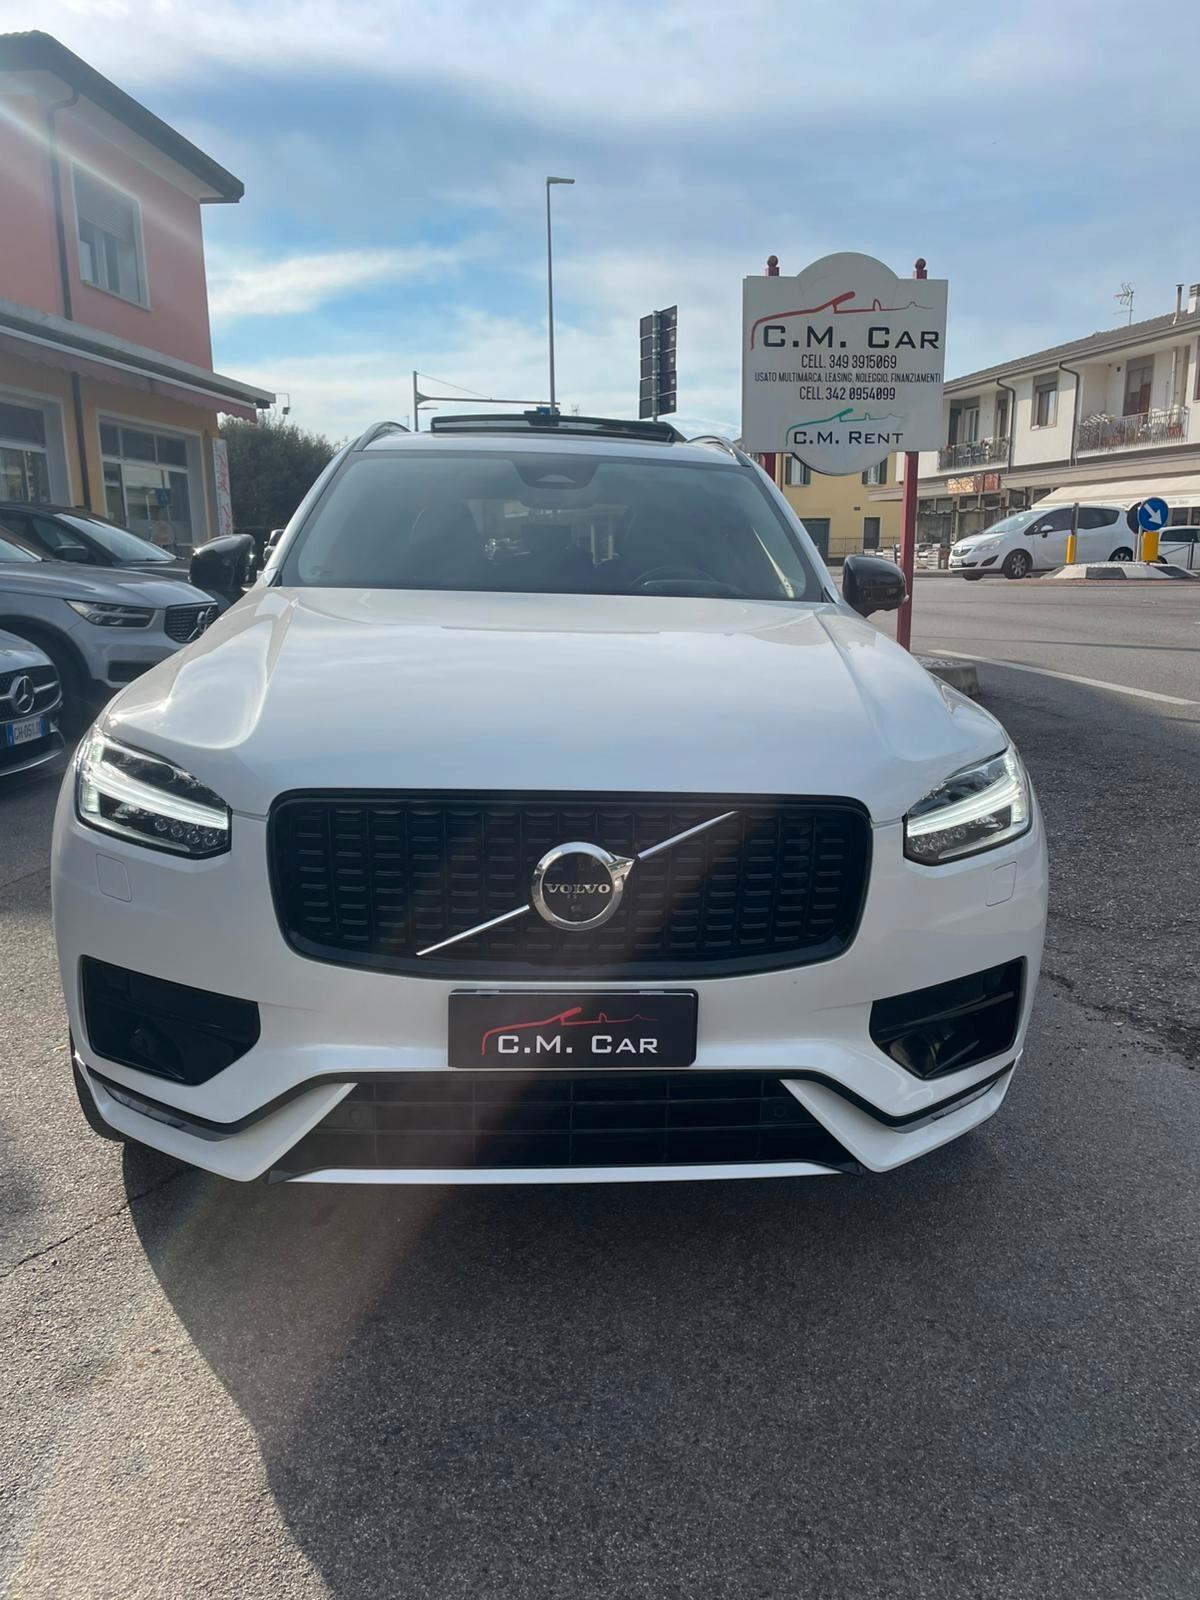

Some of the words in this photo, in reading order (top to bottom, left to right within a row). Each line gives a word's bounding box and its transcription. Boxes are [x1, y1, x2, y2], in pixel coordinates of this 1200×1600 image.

[763, 325, 847, 348] C.M.
[868, 327, 940, 350] CAR
[801, 354, 827, 369] CELL.
[829, 354, 849, 369] 349
[852, 354, 897, 369] 3915069
[754, 372, 777, 383] USATO
[890, 372, 941, 384] FINANZIAMENTI
[800, 386, 824, 400] CELL.
[825, 386, 846, 400] 342
[849, 387, 896, 400] 0954099
[793, 431, 839, 445] C.M.
[849, 431, 904, 445] RENT
[544, 883, 611, 894] VOLVO
[498, 1035, 573, 1054] C.M.
[591, 1035, 658, 1054] CAR
